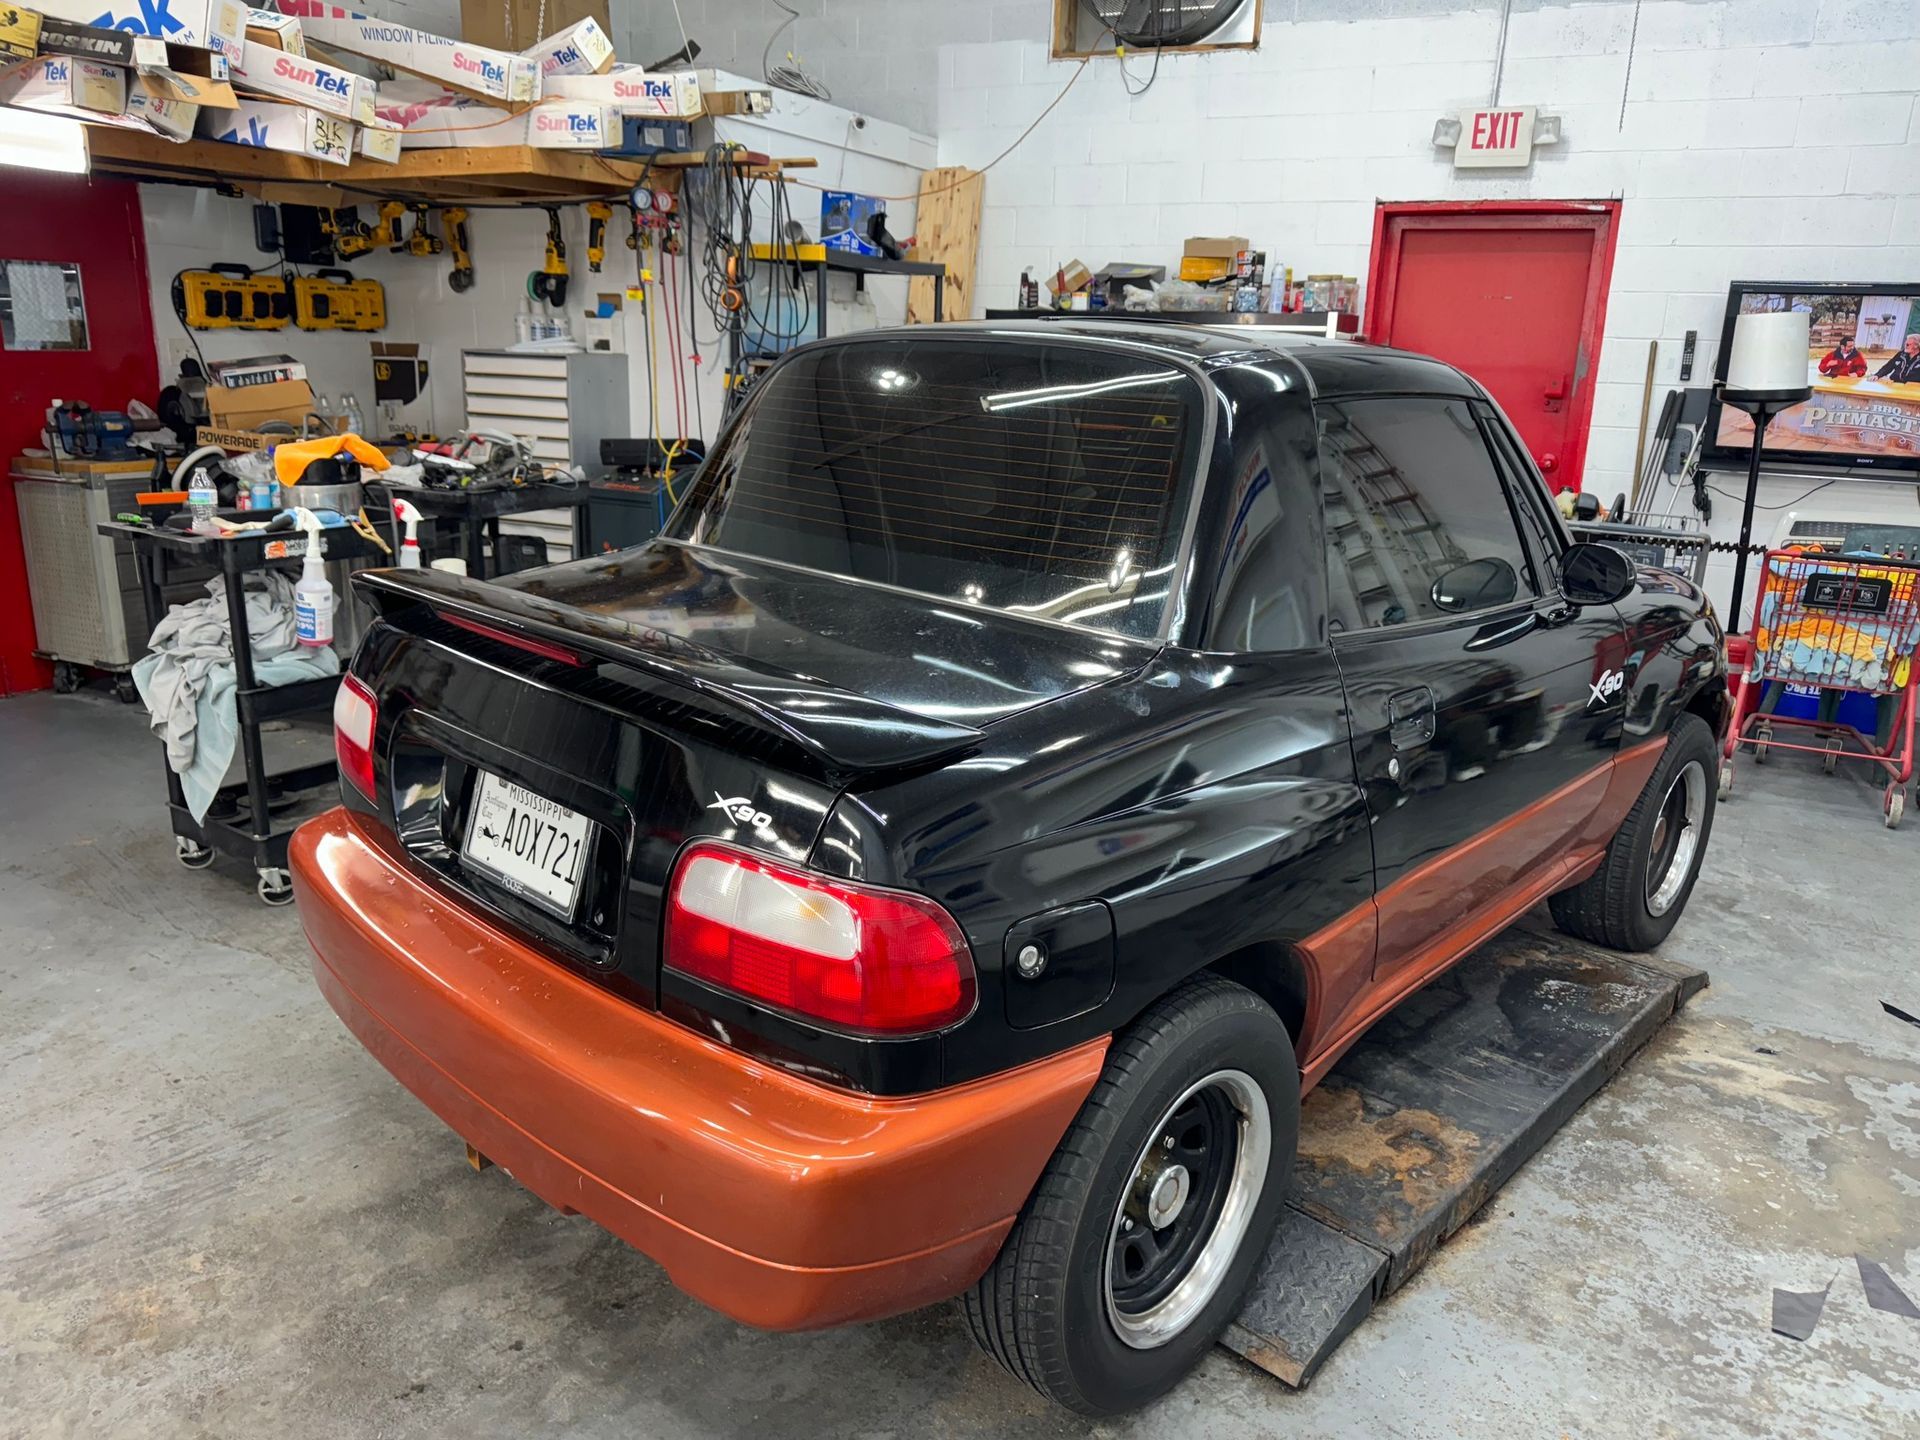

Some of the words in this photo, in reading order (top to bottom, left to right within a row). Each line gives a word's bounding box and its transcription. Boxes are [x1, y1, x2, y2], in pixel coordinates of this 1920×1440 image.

[360, 26, 413, 43] WINDOW
[453, 52, 504, 82] SunTek
[543, 46, 580, 72] unTek
[83, 65, 117, 79] SunTek
[273, 58, 351, 96] SunTek
[613, 80, 672, 97] SunTek
[536, 114, 597, 131] SunTek
[1471, 112, 1524, 149] EXIT
[1801, 408, 1920, 433] PITMAST
[198, 431, 261, 449] POWERADE
[509, 783, 564, 821] MISSISSIPPI
